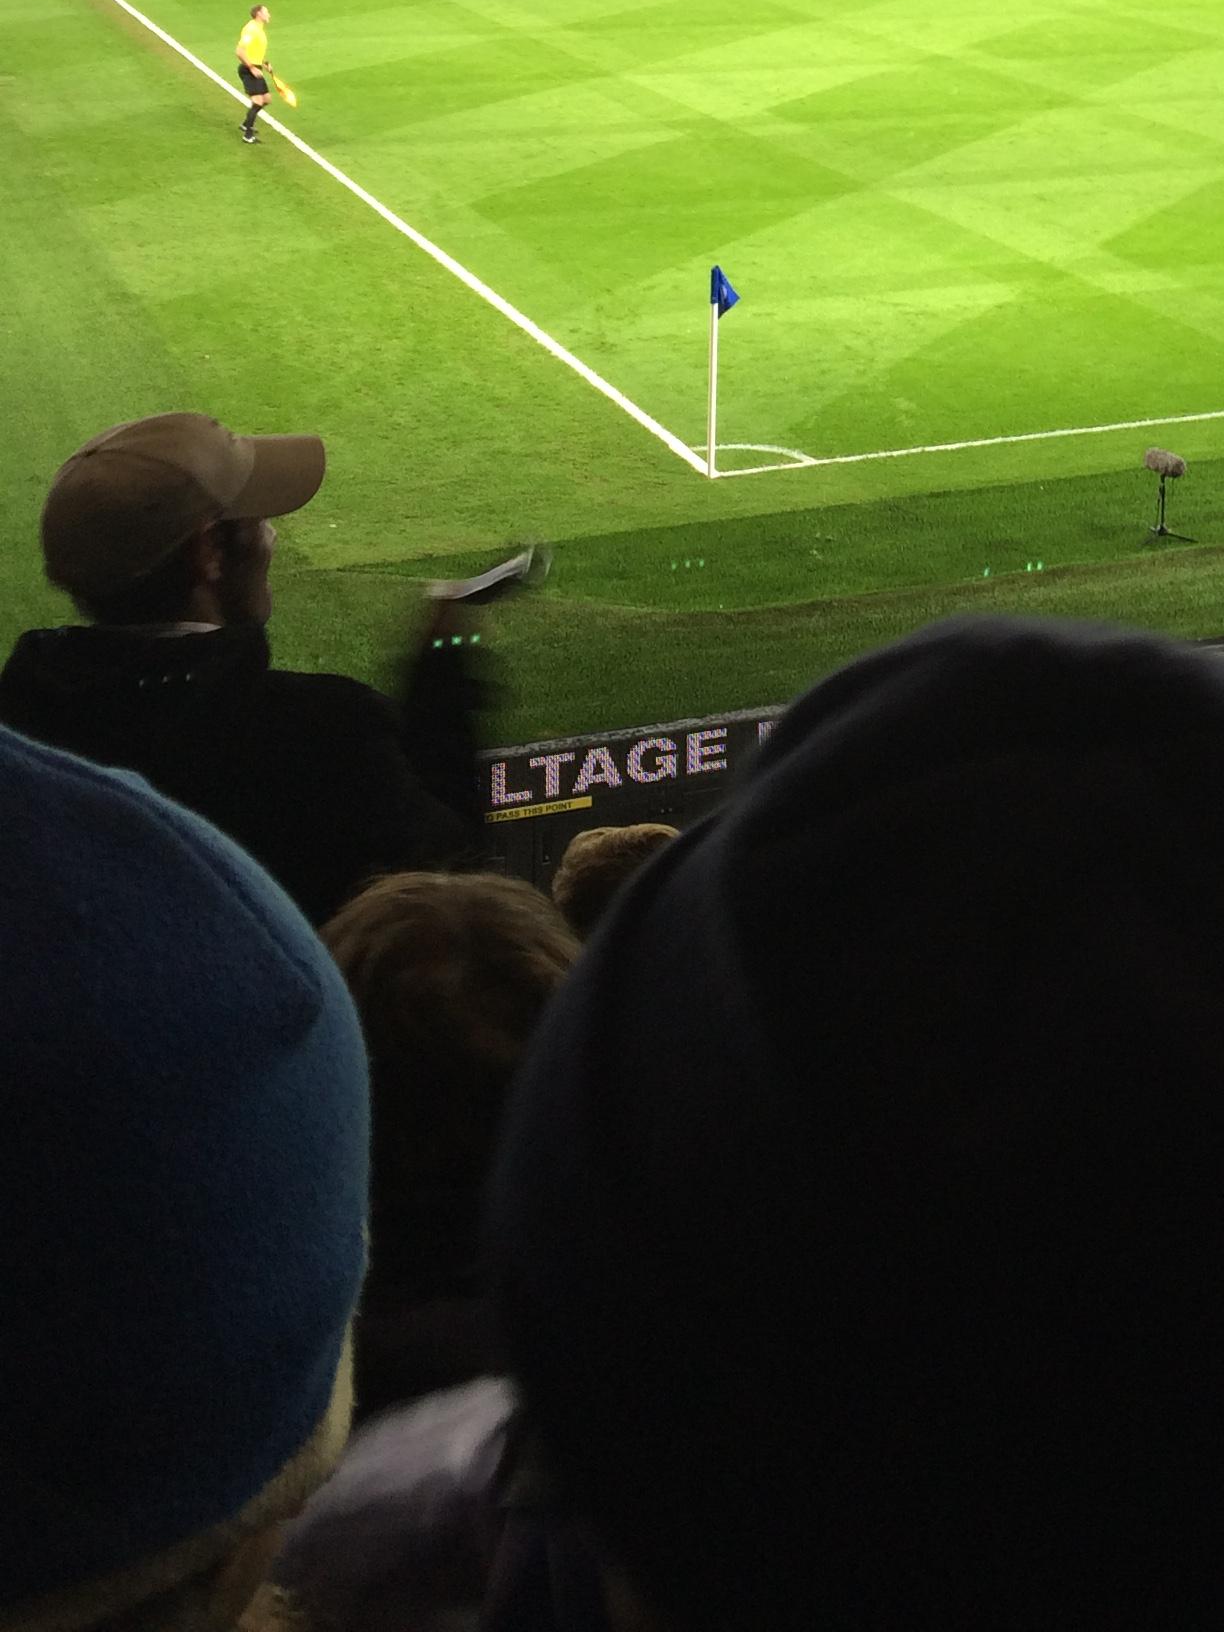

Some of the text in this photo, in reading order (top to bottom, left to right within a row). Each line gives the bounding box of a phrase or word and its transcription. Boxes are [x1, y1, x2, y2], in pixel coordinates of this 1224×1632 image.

[490, 728, 727, 807] LTAGE
[496, 809, 519, 821] PASS
[523, 805, 543, 817] THIS
[545, 801, 572, 813] POINT
